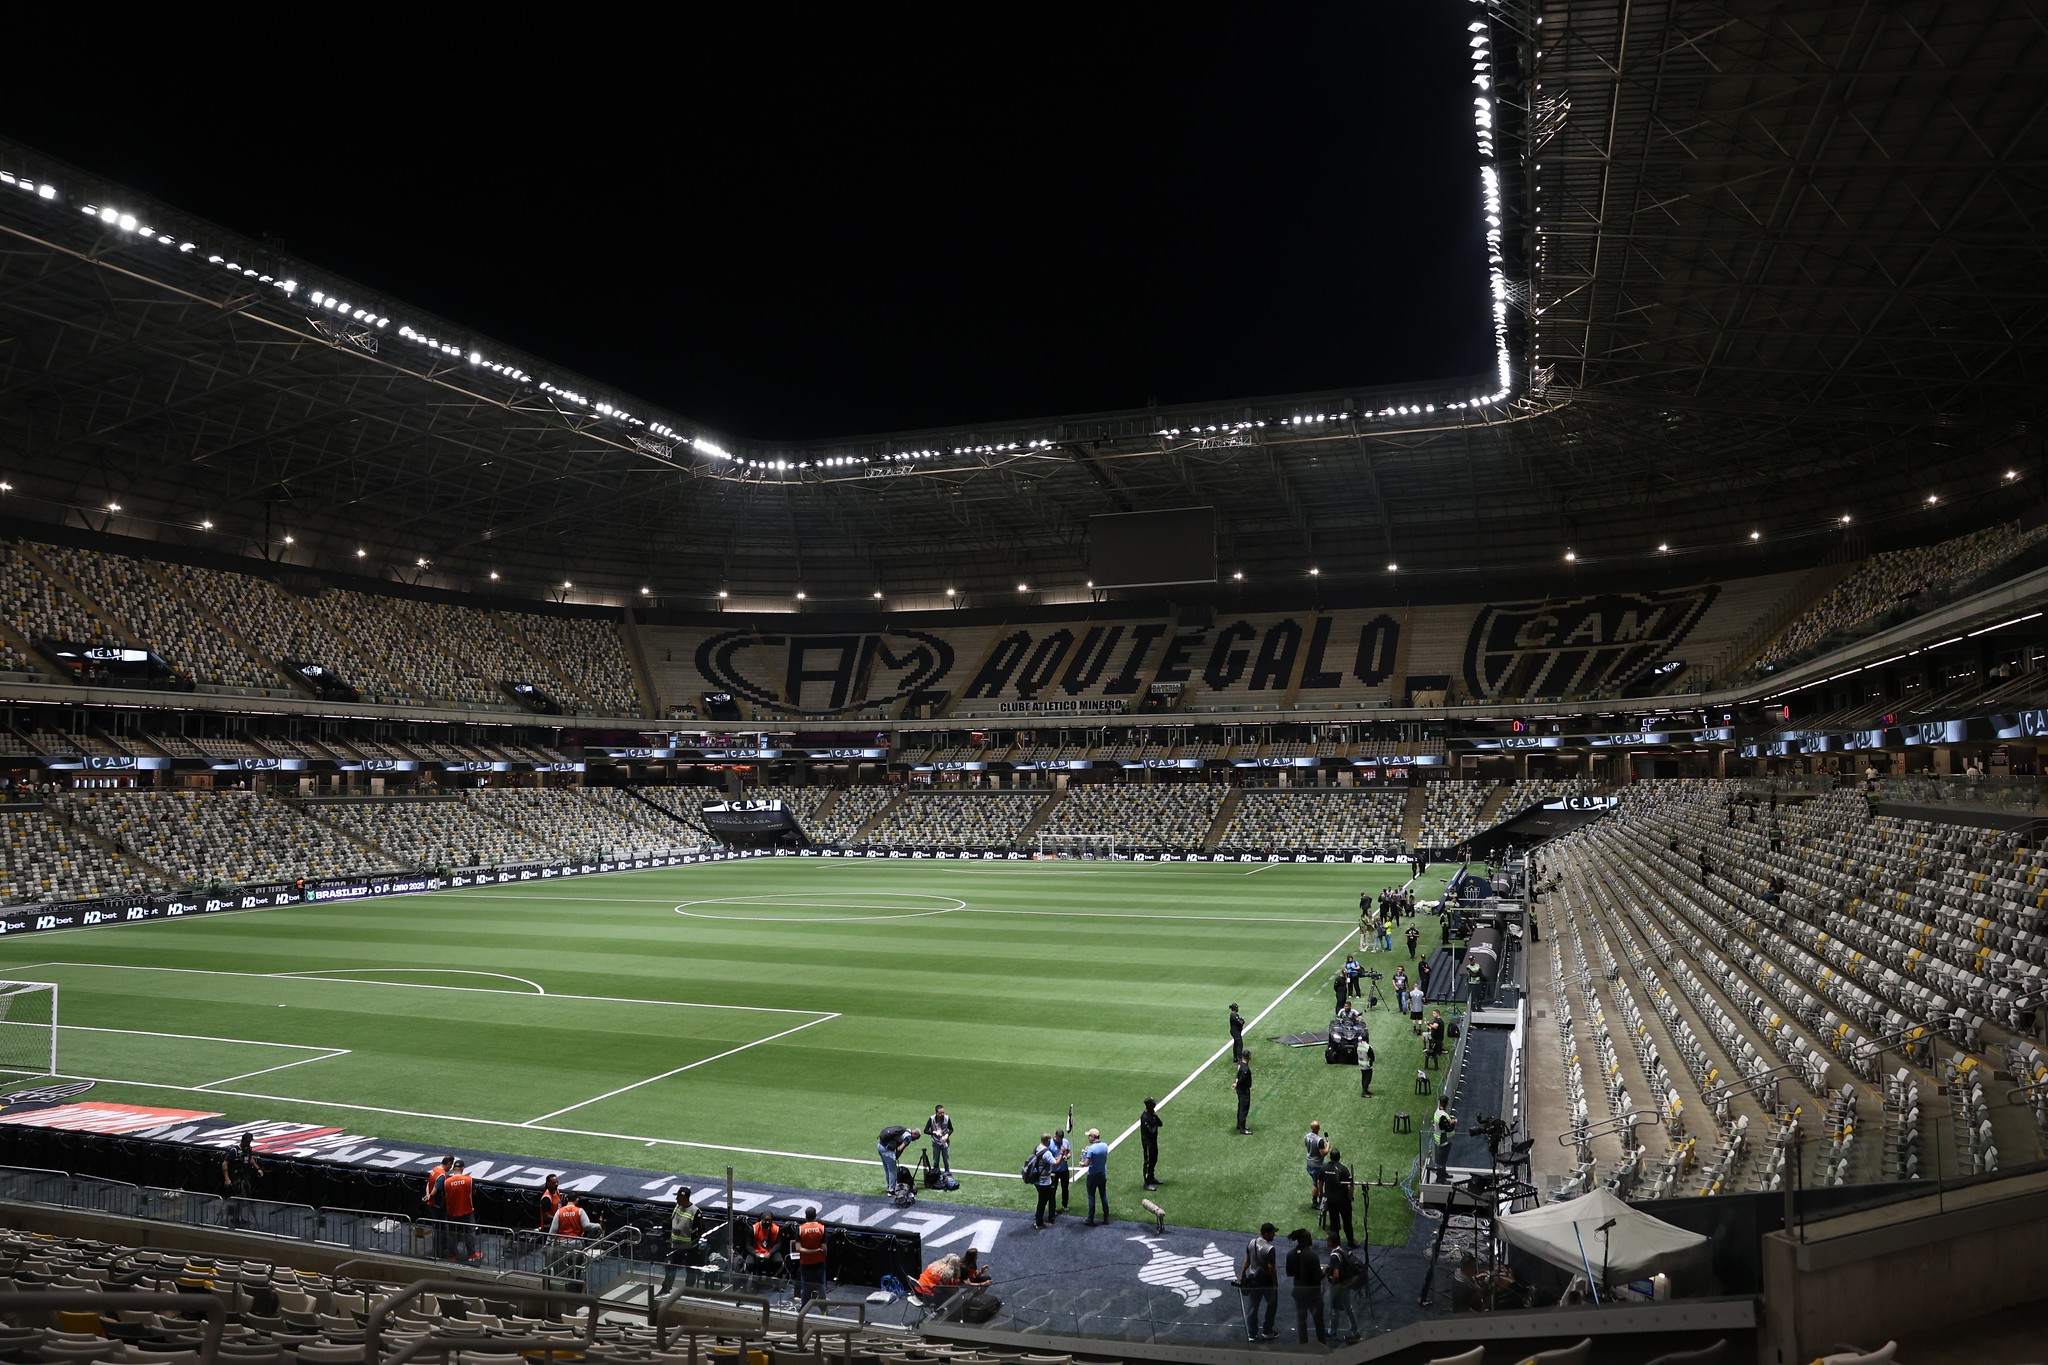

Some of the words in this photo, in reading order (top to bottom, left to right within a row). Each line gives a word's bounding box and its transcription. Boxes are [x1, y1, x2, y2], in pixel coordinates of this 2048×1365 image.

[1515, 607, 1666, 647] CAM
[964, 624, 1168, 700] AQUI
[1203, 614, 1401, 691] GALO
[1000, 702, 1031, 712] CLUBE
[1079, 700, 1122, 710] MINEIRO
[800, 849, 817, 857] H2bet
[822, 849, 840, 857] H2bet
[844, 849, 862, 857] H2bet
[866, 850, 885, 858] H2bet
[889, 850, 908, 858] H2bet
[912, 851, 931, 859] H2bet
[935, 851, 955, 859] H2bet
[959, 851, 979, 859] H2bet
[983, 851, 1003, 860] H2bet
[1007, 852, 1027, 860] H2bet
[1134, 853, 1154, 861] H2bet
[1160, 853, 1181, 861] H2bet
[1186, 853, 1207, 862] H2bet
[1213, 854, 1234, 862] H2bet
[1240, 854, 1262, 862] H2bet
[1268, 854, 1289, 863] H2bet
[1295, 855, 1317, 863] H2bet
[1352, 855, 1373, 863] H2bet
[1373, 855, 1395, 863] H2bet
[499, 872, 517, 882] H2bet
[520, 870, 538, 880] H2bet
[542, 868, 559, 878] H2bet
[452, 877, 471, 887] H2bet
[476, 875, 494, 885] H2bet
[409, 882, 425, 891] 2025
[206, 900, 234, 911] H2bet
[242, 897, 268, 908] H2bet
[127, 907, 158, 919] H2bt
[167, 903, 197, 915] H2bet
[83, 911, 117, 924] H2bet
[0, 920, 25, 933] 2bet
[36, 916, 73, 929] H2bet
